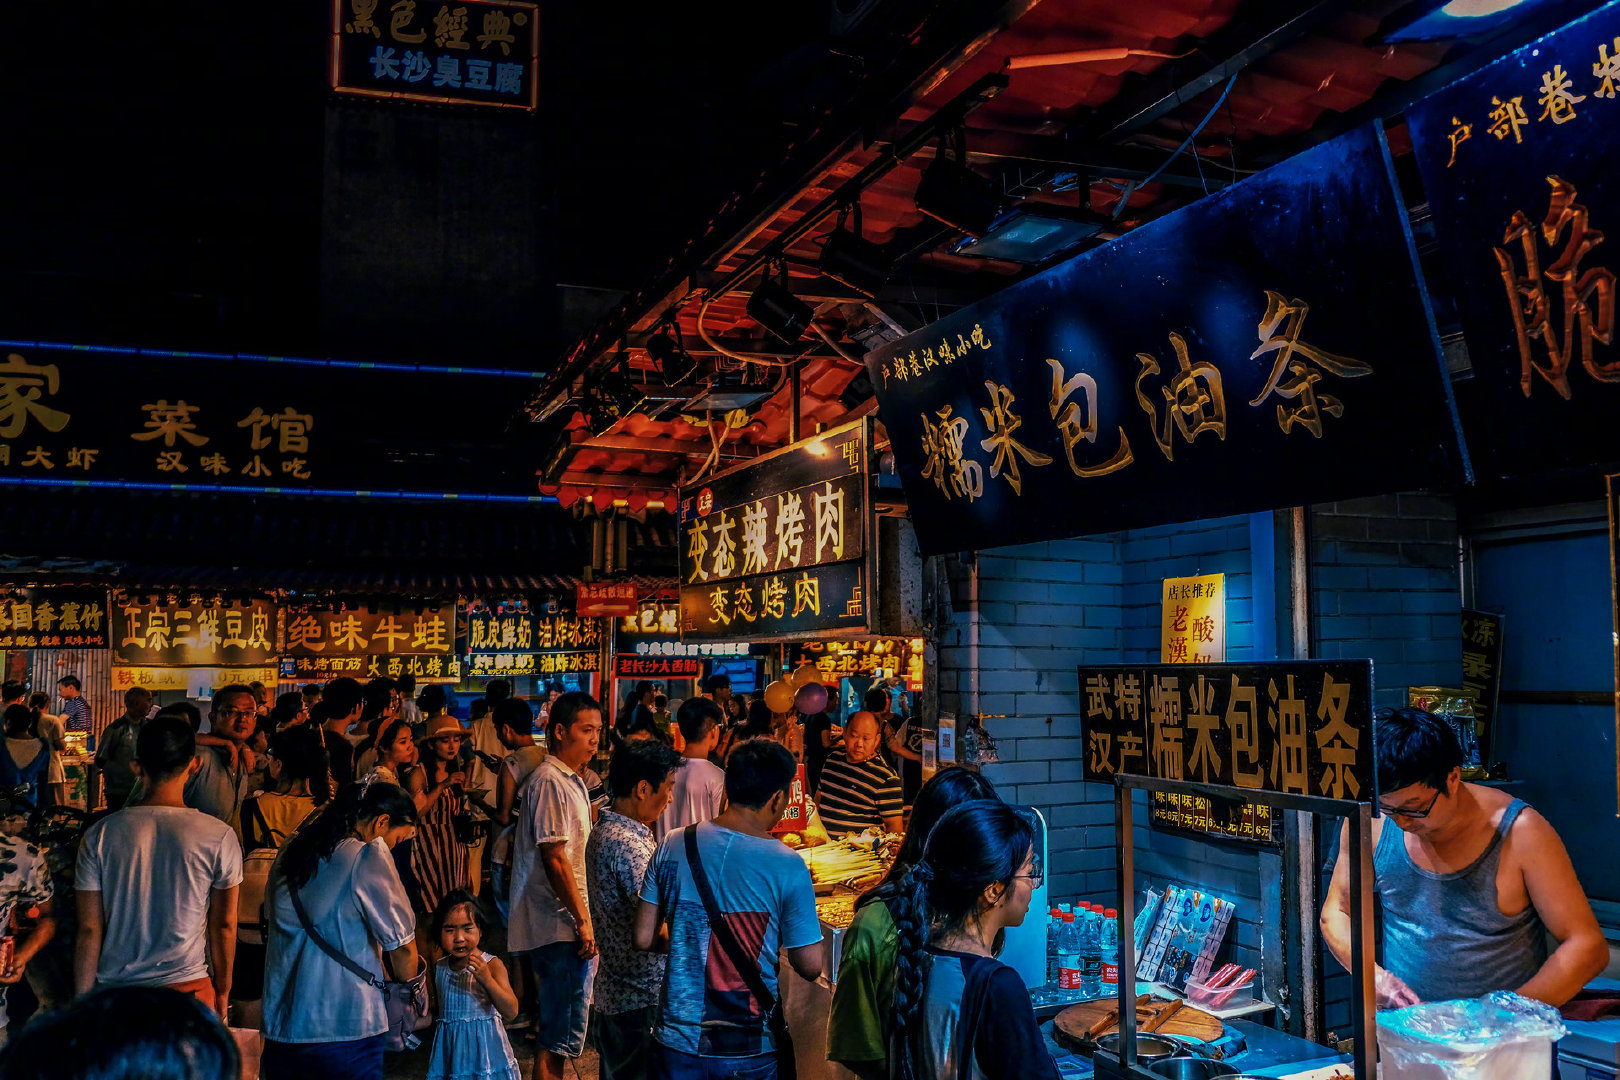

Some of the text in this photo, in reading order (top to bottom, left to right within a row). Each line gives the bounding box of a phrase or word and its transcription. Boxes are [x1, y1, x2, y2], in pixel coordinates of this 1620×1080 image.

[370, 46, 524, 94] 长沙臭豆腐
[881, 323, 992, 390] 户部巷汉味小吃
[920, 289, 1374, 503] 糯米包油条
[156, 451, 312, 480] 汉味小吃
[688, 481, 845, 584] 变态辣烤肉
[709, 571, 821, 625] 变态烤肉
[1167, 582, 1216, 601] 店长推荐
[122, 606, 272, 651] 正宗三鲜豆皮
[286, 614, 451, 653] 绝味牛蛙
[470, 615, 602, 650] 脆皮鲜奶 油炸冰淇
[280, 656, 362, 677] 味烤面筋
[367, 655, 461, 677] 大西北烤肉
[473, 652, 601, 673] 炸鲜奶 油炸冰淇
[619, 659, 698, 674] 老长沙大香肠
[1149, 671, 1361, 800] 糯米包油条
[1155, 809, 1166, 820] 8元
[1167, 811, 1179, 822] 8元
[1194, 815, 1206, 827] 7元
[1255, 825, 1270, 836] 6元
[1168, 792, 1179, 805] 味
[1181, 794, 1193, 807] 味
[1194, 796, 1206, 810] 松
[1256, 804, 1270, 819] 味
